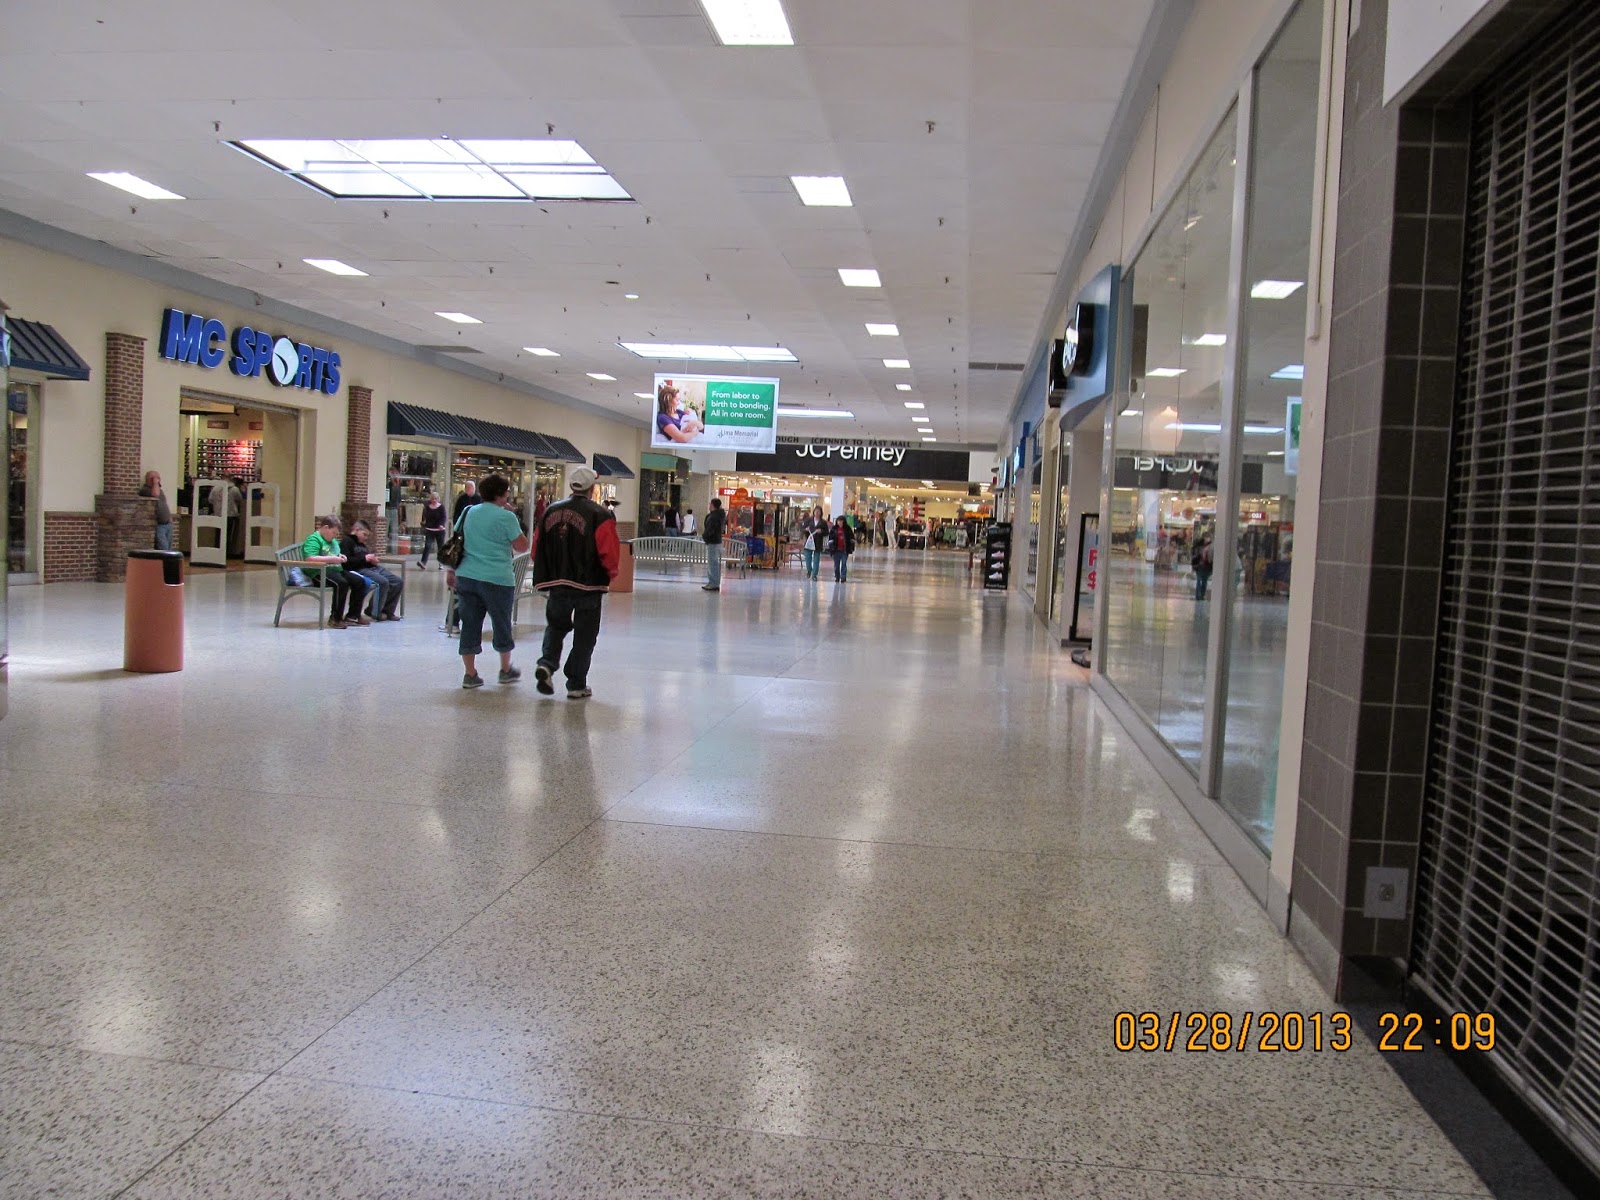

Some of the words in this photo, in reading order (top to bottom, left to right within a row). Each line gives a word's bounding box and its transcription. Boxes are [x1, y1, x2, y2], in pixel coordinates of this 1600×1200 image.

[158, 308, 226, 369] MC
[228, 326, 342, 396] SPORTS
[711, 390, 731, 399] From
[731, 391, 751, 400] labor
[751, 393, 760, 401] to
[711, 400, 729, 408] birth
[738, 401, 771, 412] bonding.
[721, 410, 729, 418] in
[744, 412, 766, 420] room.
[733, 430, 759, 438] Memorial
[795, 444, 906, 466] JCPenney
